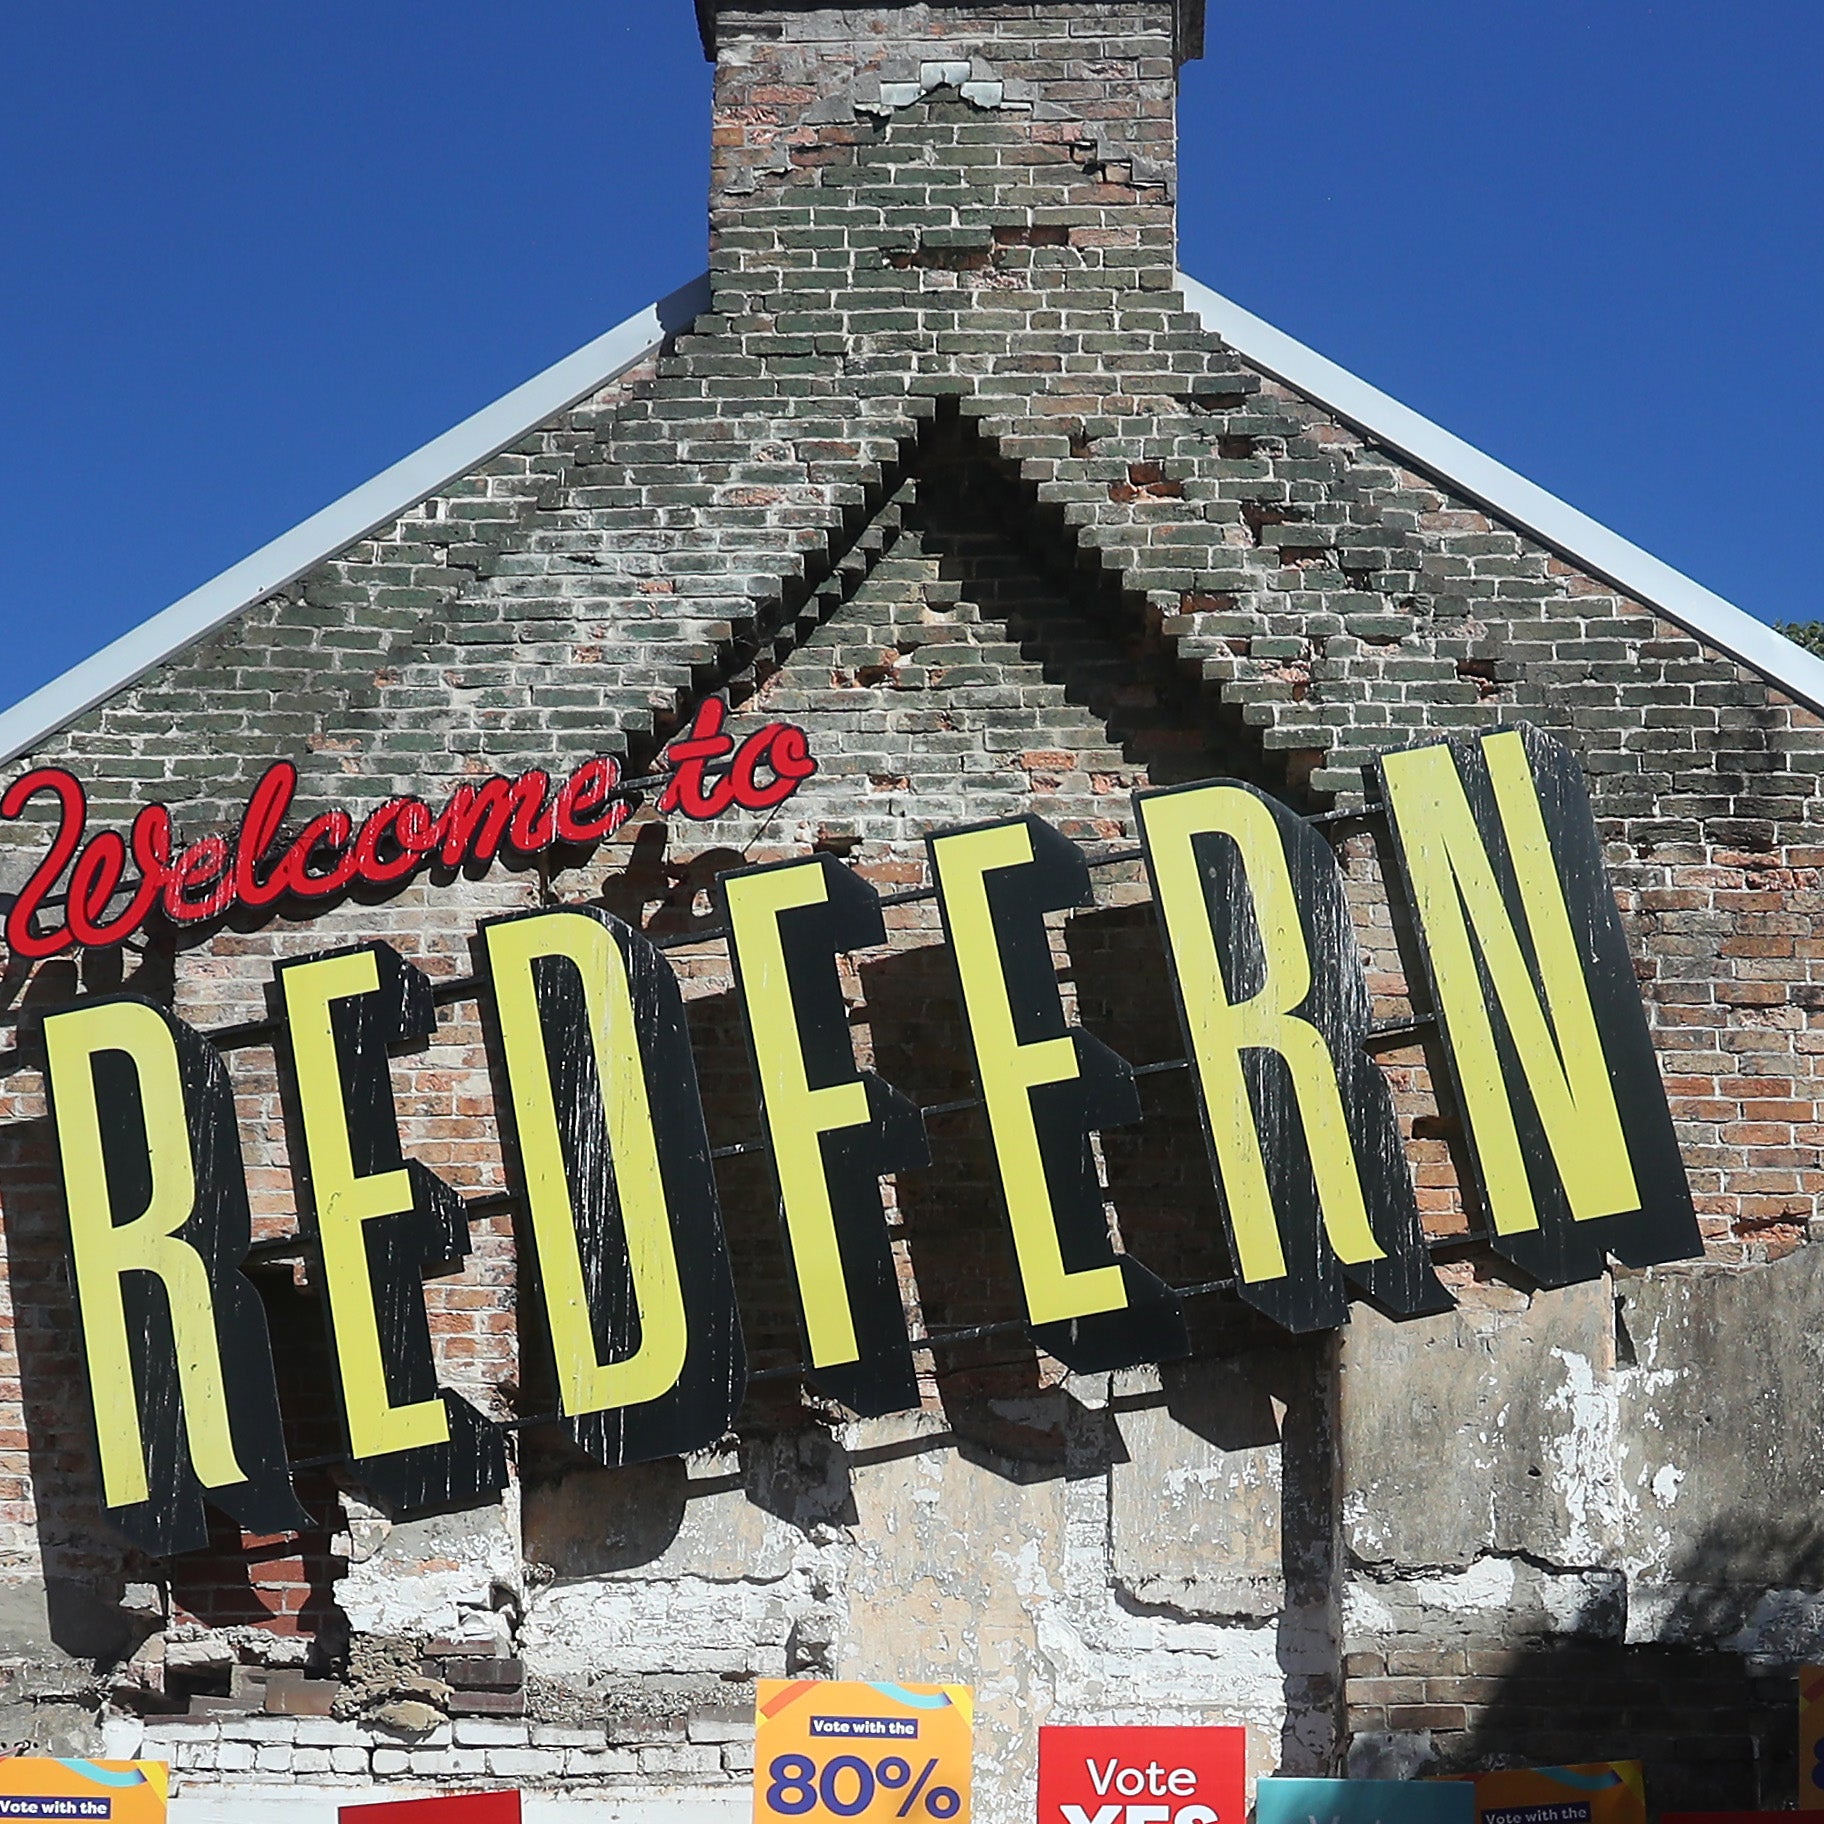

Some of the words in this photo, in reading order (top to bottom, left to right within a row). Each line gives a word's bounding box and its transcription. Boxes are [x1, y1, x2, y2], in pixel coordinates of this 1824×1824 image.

[656, 695, 818, 821] to
[40, 722, 1658, 1518] REDFERN
[812, 1716, 847, 1733] Vote
[849, 1716, 881, 1734] with
[883, 1717, 916, 1735] the
[767, 1754, 960, 1819] 80%
[1087, 1759, 1196, 1795] Vote
[0, 1799, 35, 1815] Vote
[40, 1799, 71, 1815] with
[74, 1799, 108, 1815] the
[1524, 1808, 1558, 1823] with
[1561, 1807, 1587, 1820] the
